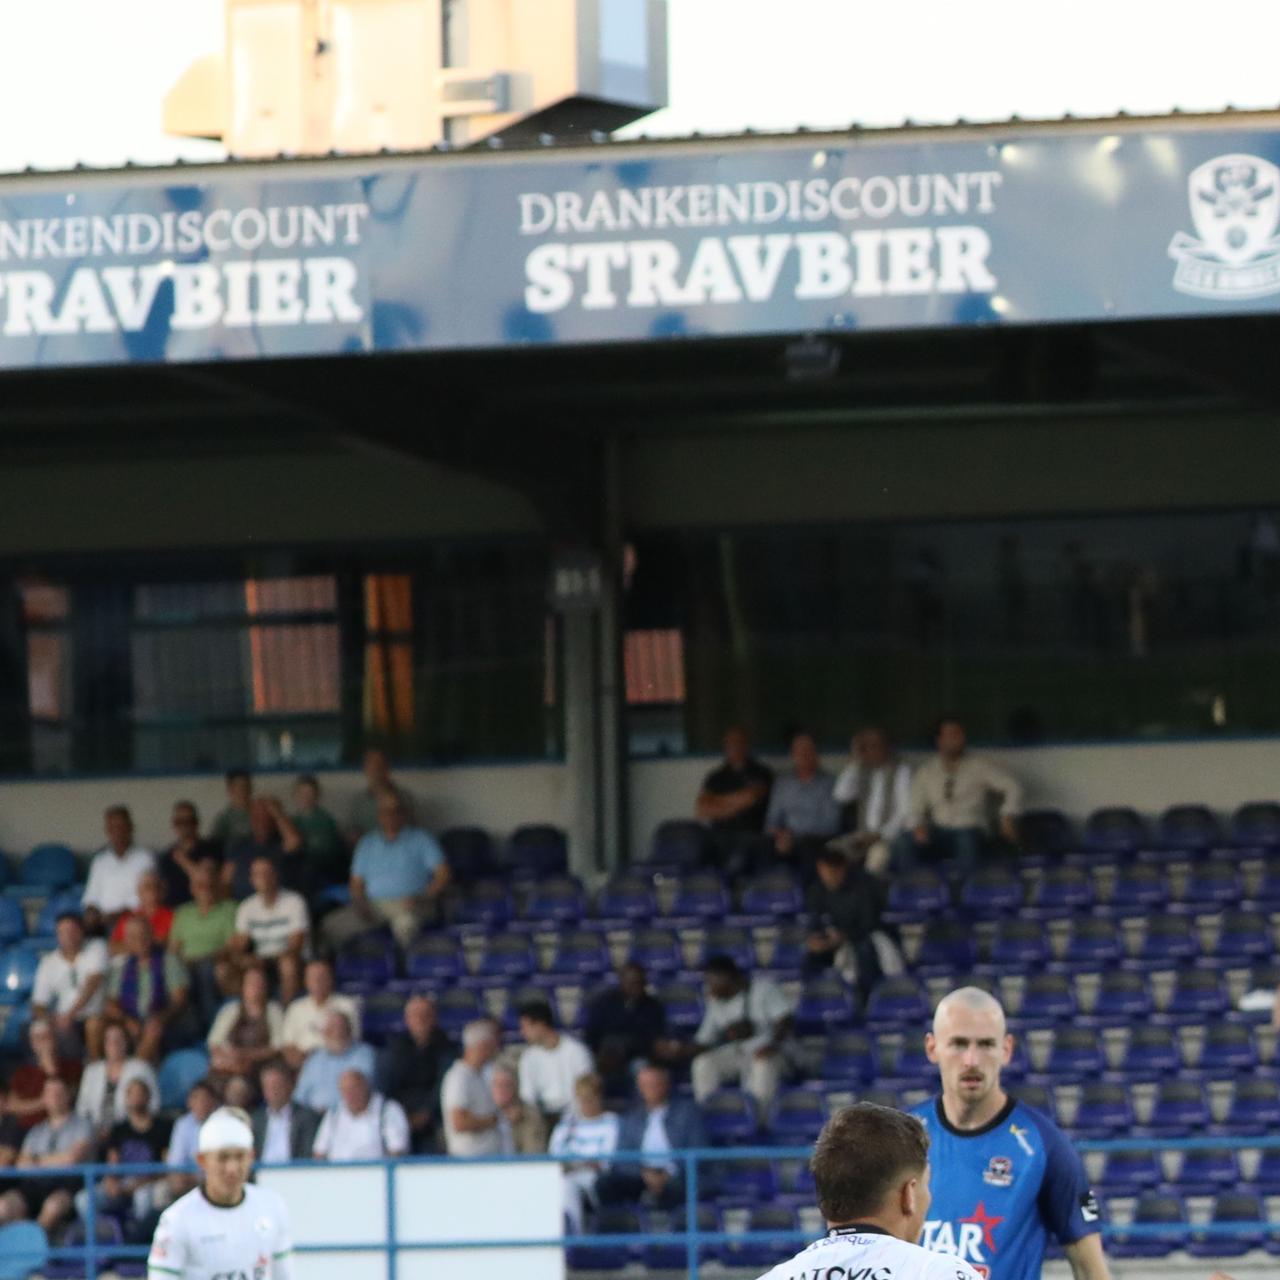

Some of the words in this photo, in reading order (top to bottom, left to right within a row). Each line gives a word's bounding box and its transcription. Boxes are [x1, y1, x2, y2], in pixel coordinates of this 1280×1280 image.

[0, 203, 368, 260] NKENDISCOUNT
[517, 171, 1003, 236] DRANKENDISCOUNT
[0, 256, 364, 337] RAVBIER
[920, 1218, 988, 1264] TAR
